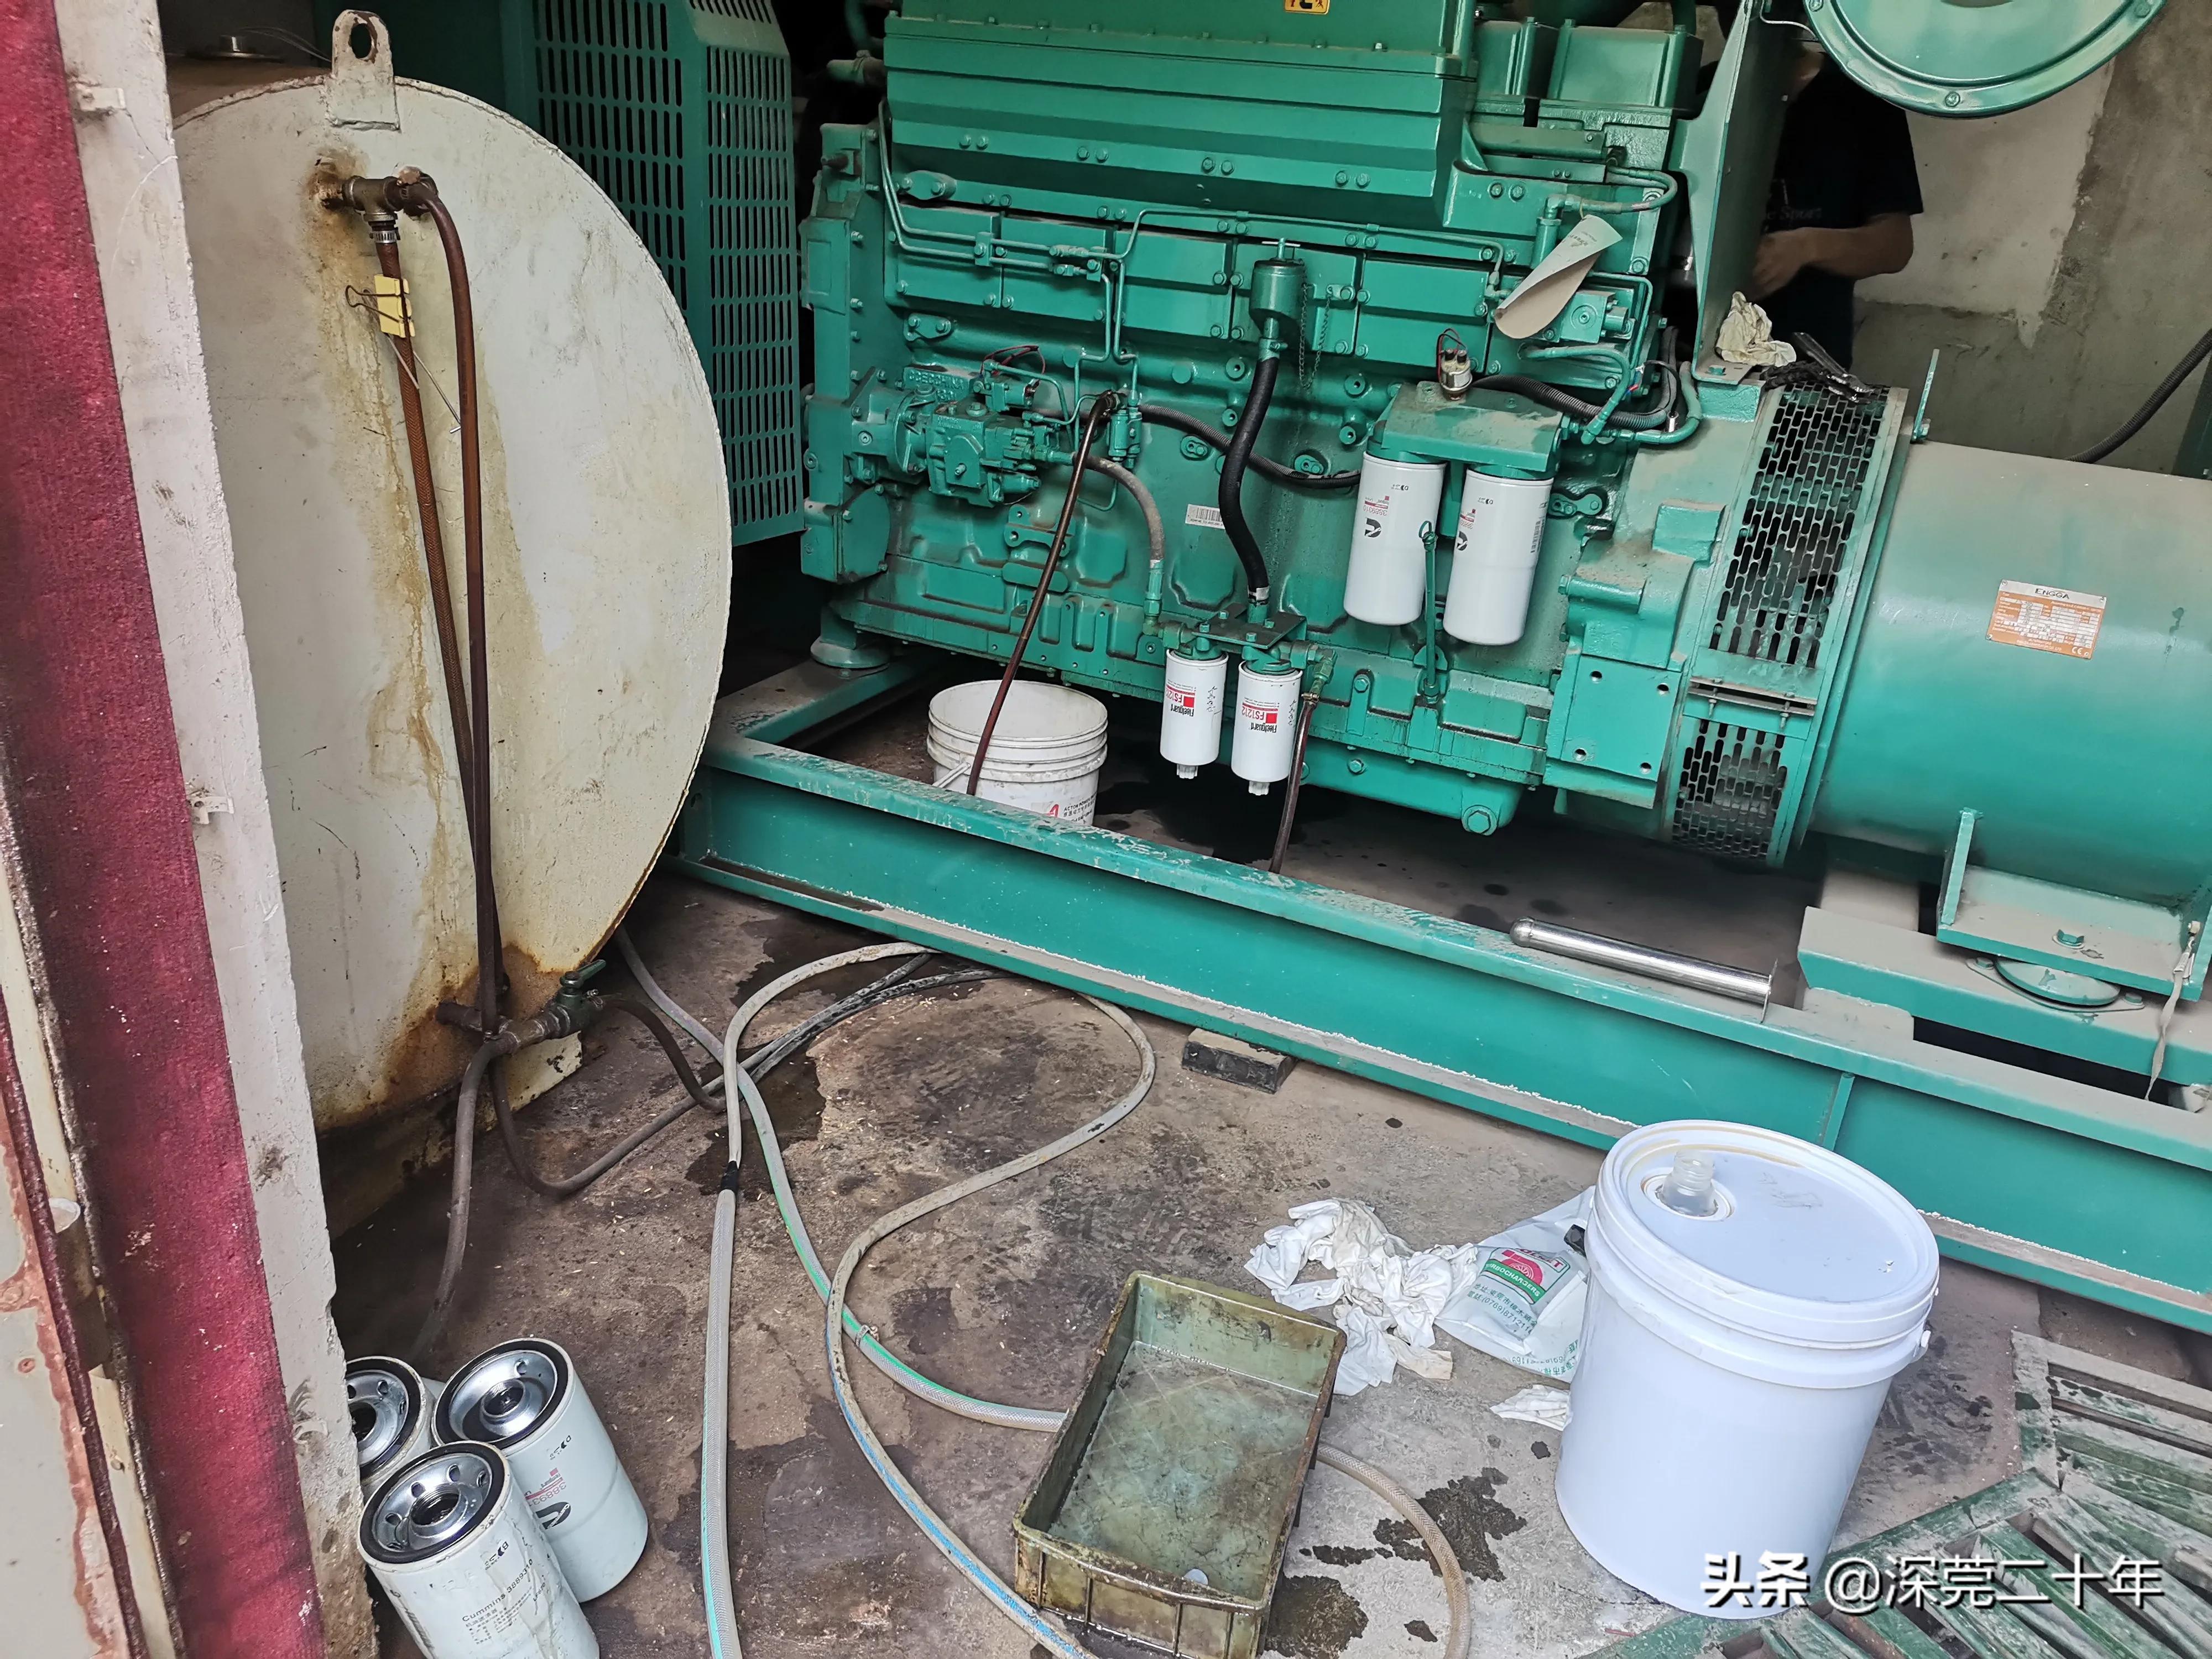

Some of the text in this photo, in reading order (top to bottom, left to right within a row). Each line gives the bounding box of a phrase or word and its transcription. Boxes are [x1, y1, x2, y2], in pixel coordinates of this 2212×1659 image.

[2034, 588, 2070, 599] ENGGA
[1241, 706, 1265, 721] FS1212
[462, 1593, 505, 1622] Cummins
[507, 1559, 533, 1593] 3889310
